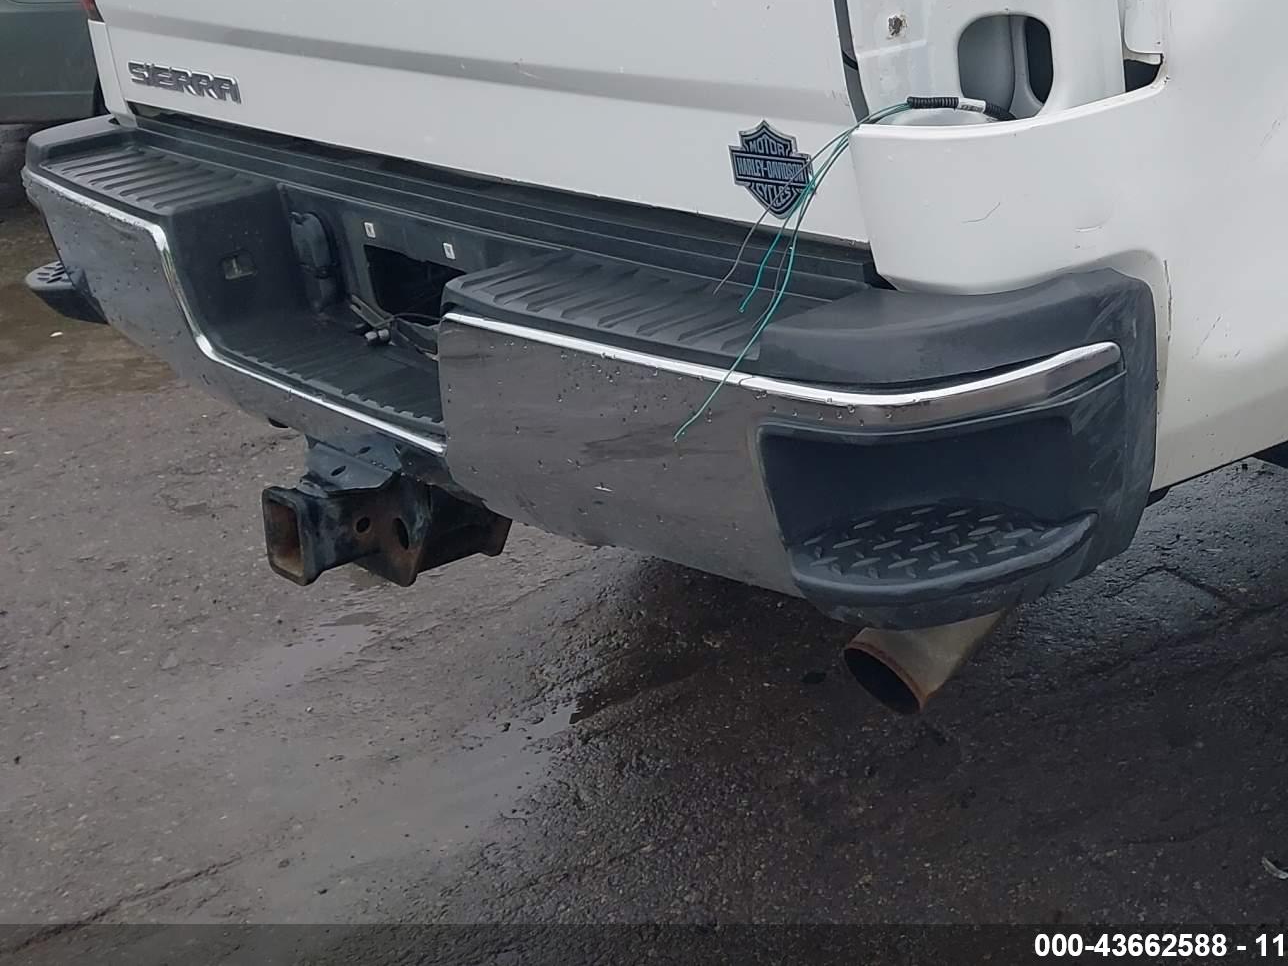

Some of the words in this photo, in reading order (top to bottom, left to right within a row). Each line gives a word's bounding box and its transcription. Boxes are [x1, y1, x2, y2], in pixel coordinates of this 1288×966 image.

[127, 60, 242, 105] SIERRA
[748, 134, 787, 157] MOTOR
[735, 155, 805, 183] HARLEY-DAVIDSON
[755, 182, 793, 208] CYCLES
